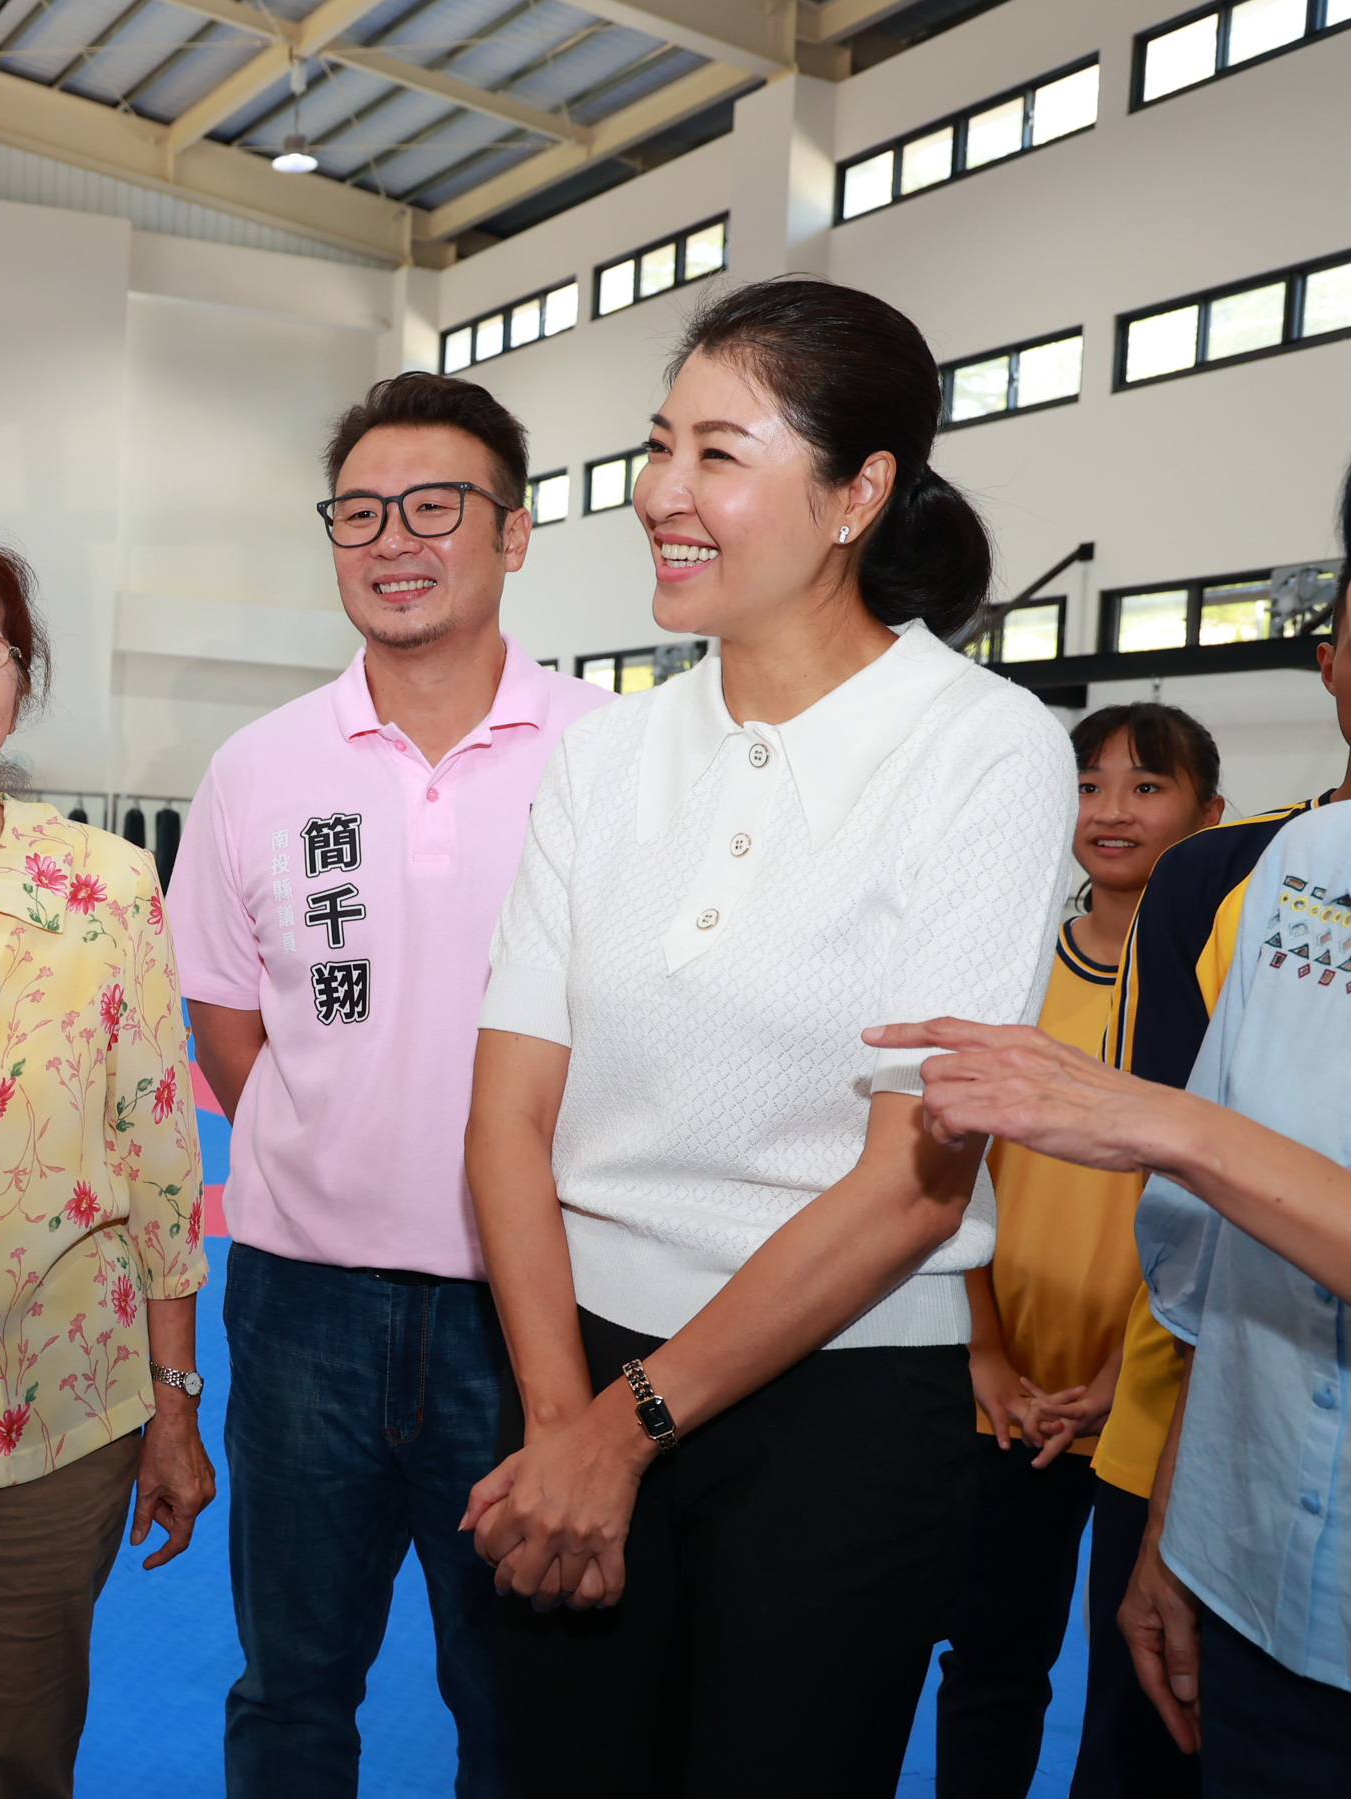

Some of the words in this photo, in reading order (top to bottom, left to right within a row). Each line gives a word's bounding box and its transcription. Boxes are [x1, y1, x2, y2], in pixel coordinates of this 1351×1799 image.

[270, 828, 298, 955] 南投縣議員
[300, 813, 371, 1026] 簡千翔
